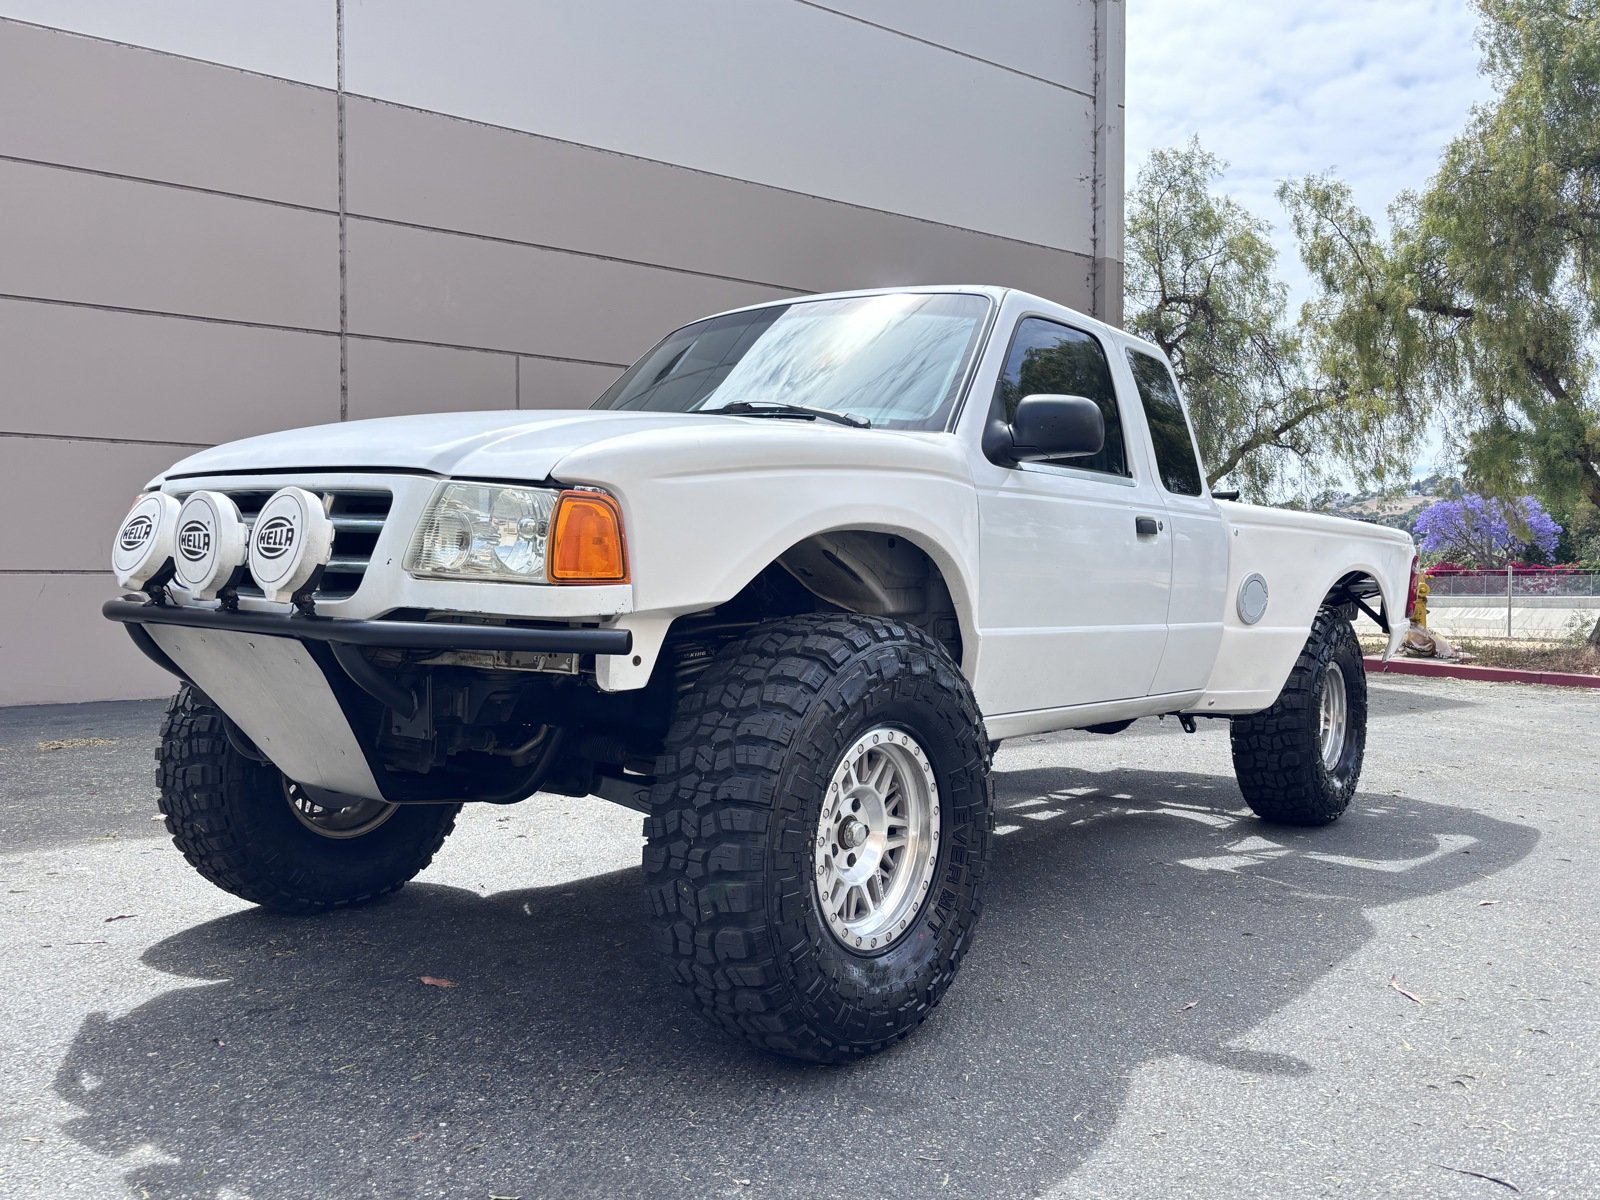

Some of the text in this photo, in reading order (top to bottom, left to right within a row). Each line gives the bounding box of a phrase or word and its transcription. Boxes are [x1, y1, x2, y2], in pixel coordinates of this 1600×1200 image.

[122, 523, 151, 540] HELLA
[259, 528, 294, 547] HELLA
[181, 532, 210, 551] HELLA
